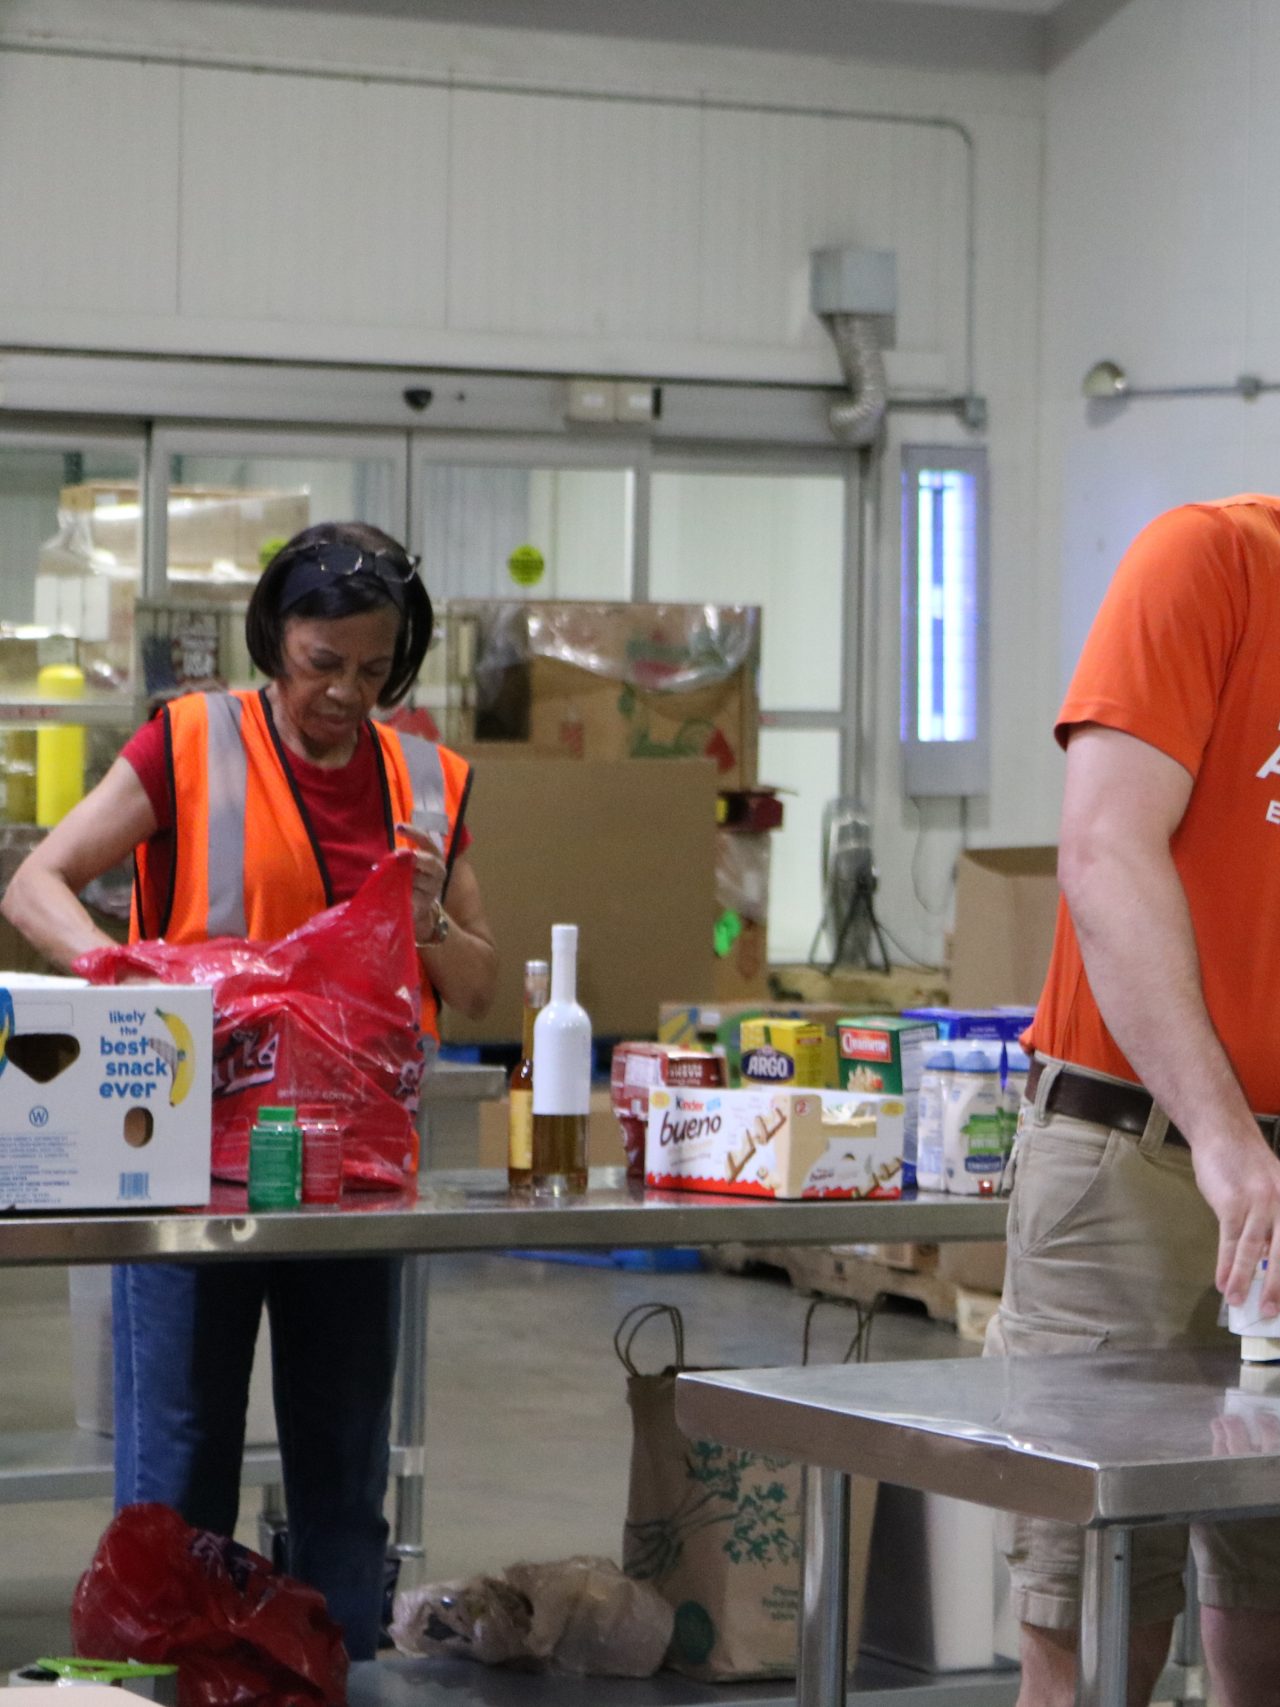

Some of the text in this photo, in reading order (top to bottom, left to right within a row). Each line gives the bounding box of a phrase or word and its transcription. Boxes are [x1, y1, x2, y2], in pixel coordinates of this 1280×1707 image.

[109, 1009, 146, 1026] likely
[120, 1026, 138, 1036] the
[100, 1036, 149, 1055] best
[106, 1057, 168, 1076] snack
[747, 1055, 789, 1079] ARGO
[99, 1082, 157, 1098] ever
[660, 1111, 722, 1147] bueno
